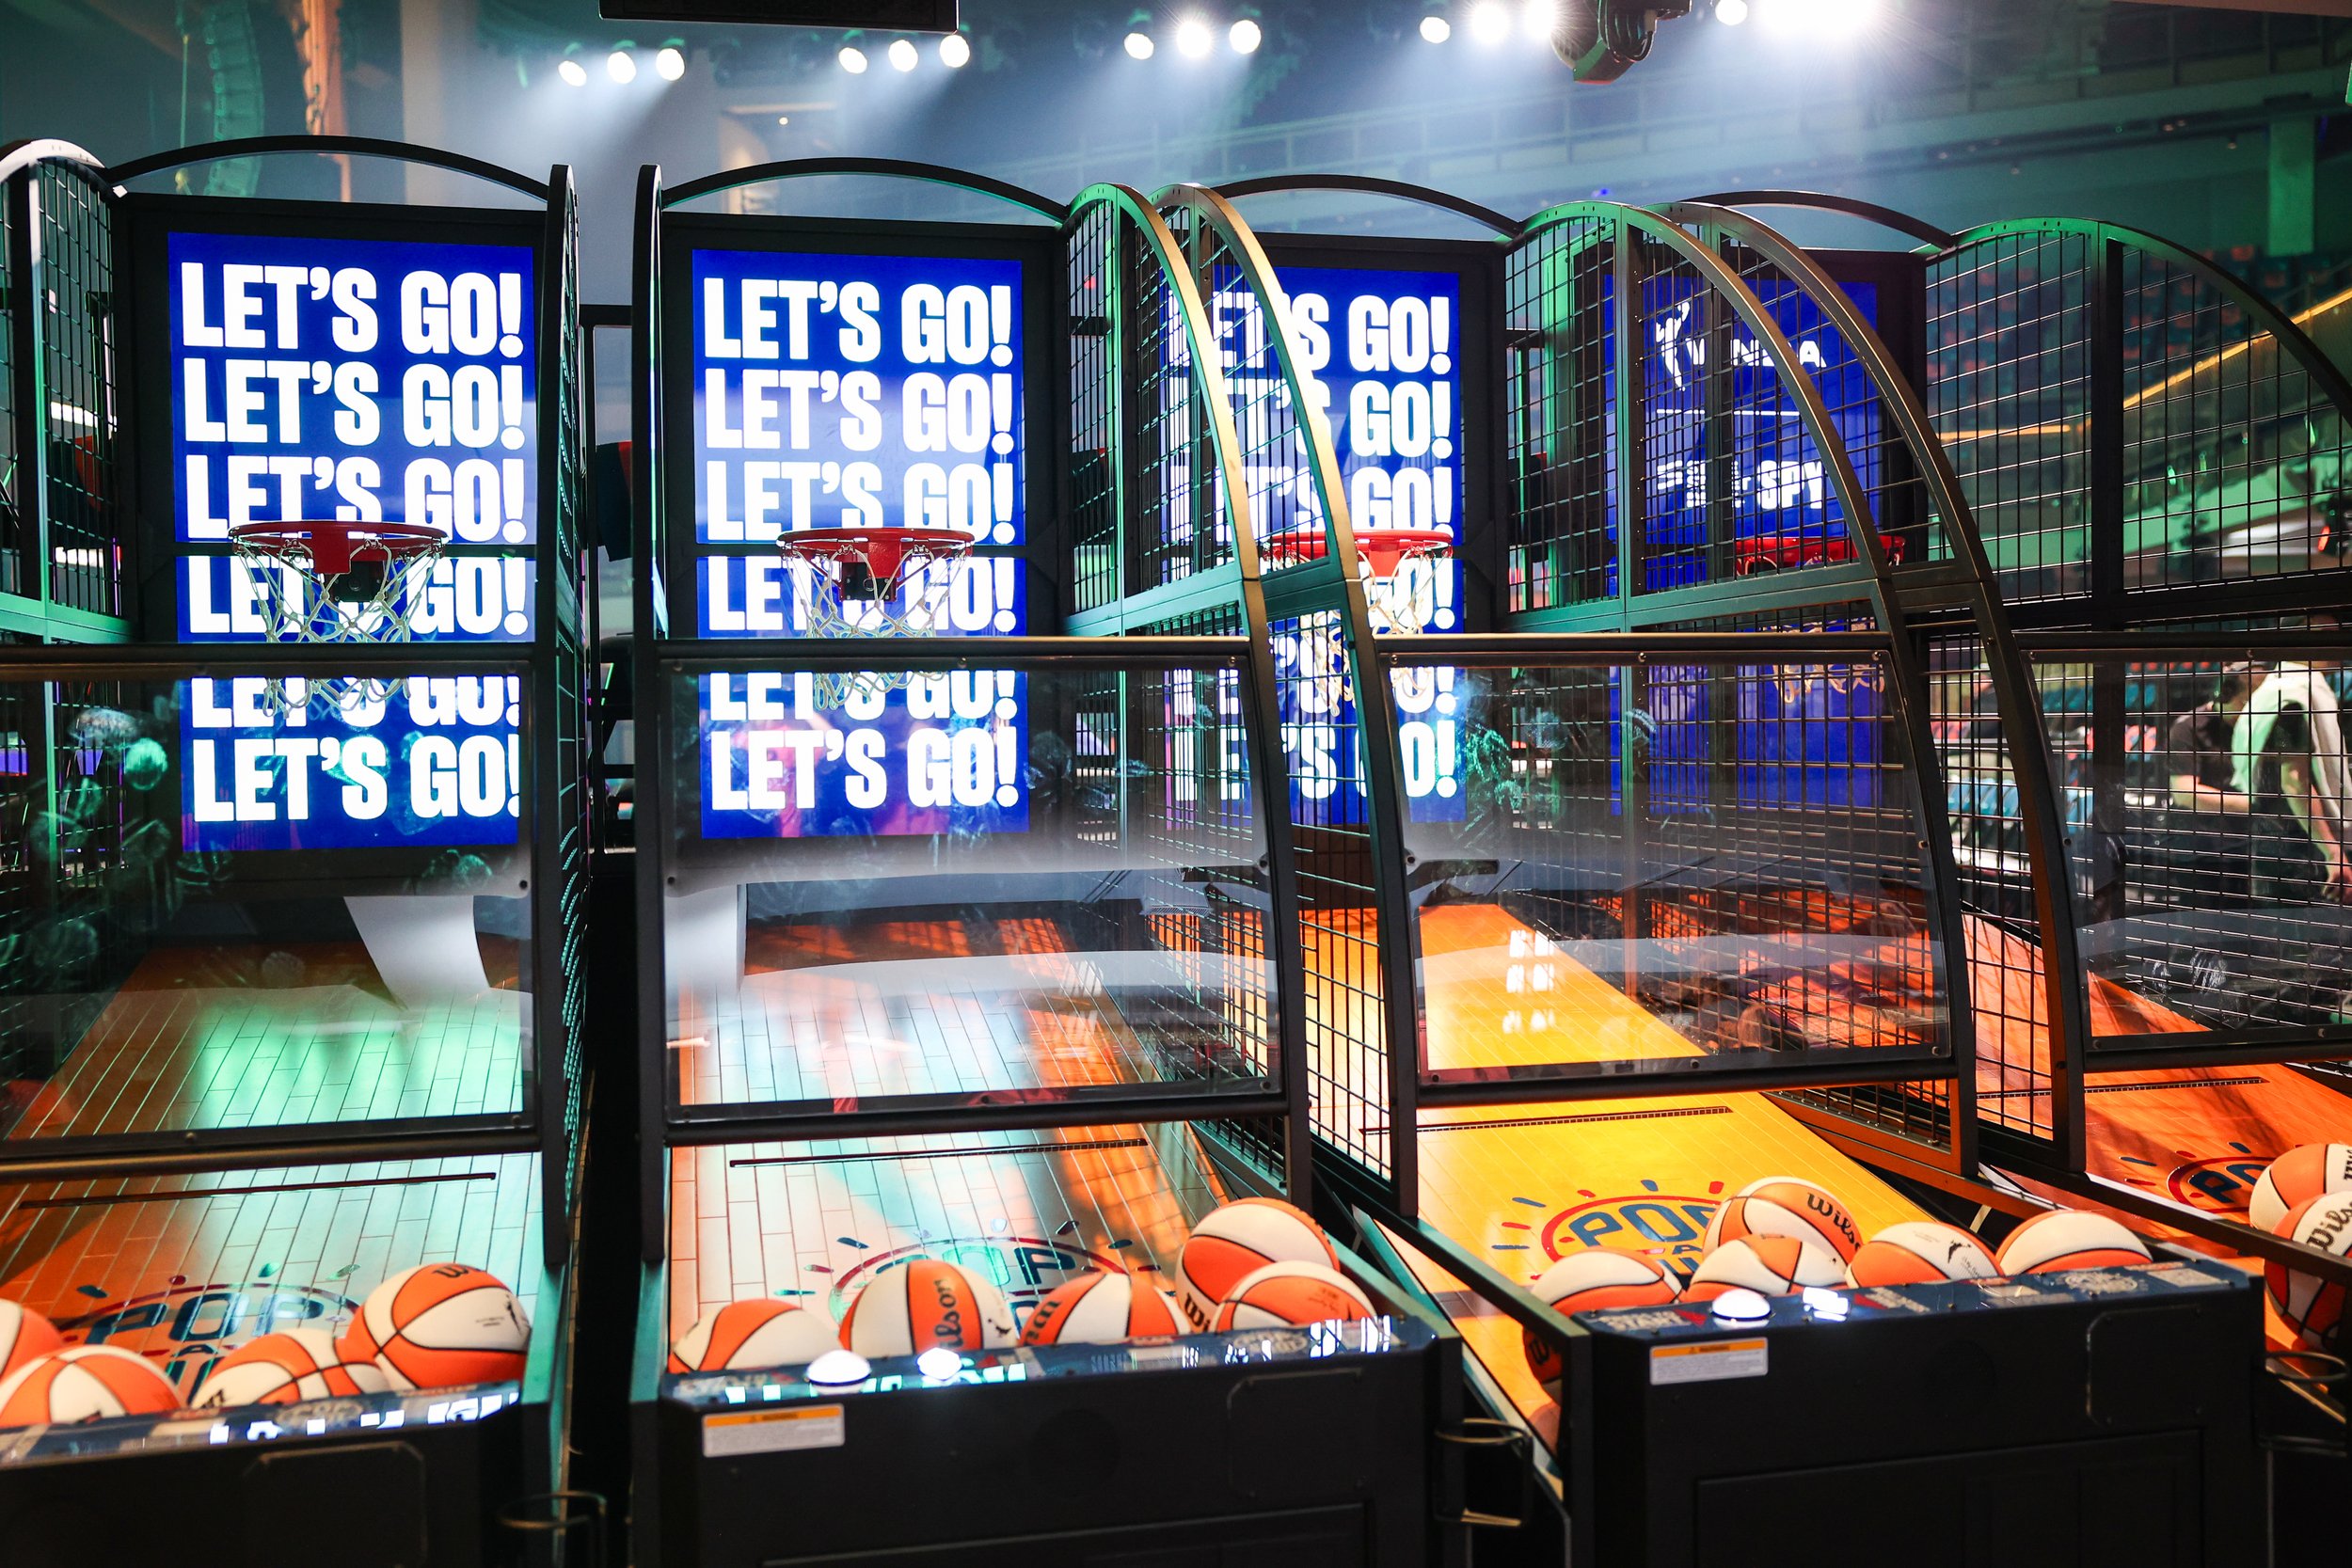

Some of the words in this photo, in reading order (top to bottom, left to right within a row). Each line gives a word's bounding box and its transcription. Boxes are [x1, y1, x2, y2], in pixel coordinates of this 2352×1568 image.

[181, 262, 378, 353] LET'S
[400, 272, 524, 358] GO!
[703, 277, 882, 364] LET'S
[900, 284, 1014, 368] GO!
[1348, 294, 1452, 374] GO!
[183, 357, 381, 447] LET'S
[402, 364, 526, 451] GO!
[705, 368, 883, 451] LET'S
[901, 372, 1015, 455] GO!
[1349, 380, 1454, 459] GO!
[185, 454, 383, 541] LET'S
[403, 458, 528, 544] GO!
[706, 461, 884, 542] LET'S
[903, 462, 1017, 546] GO!
[1351, 467, 1454, 535] GO!
[405, 557, 529, 636] GO!
[193, 736, 389, 822] LET'S
[409, 733, 520, 818] GO!
[710, 729, 887, 811] LET'S
[907, 725, 1019, 809] GO!
[933, 1279, 964, 1349] ilson
